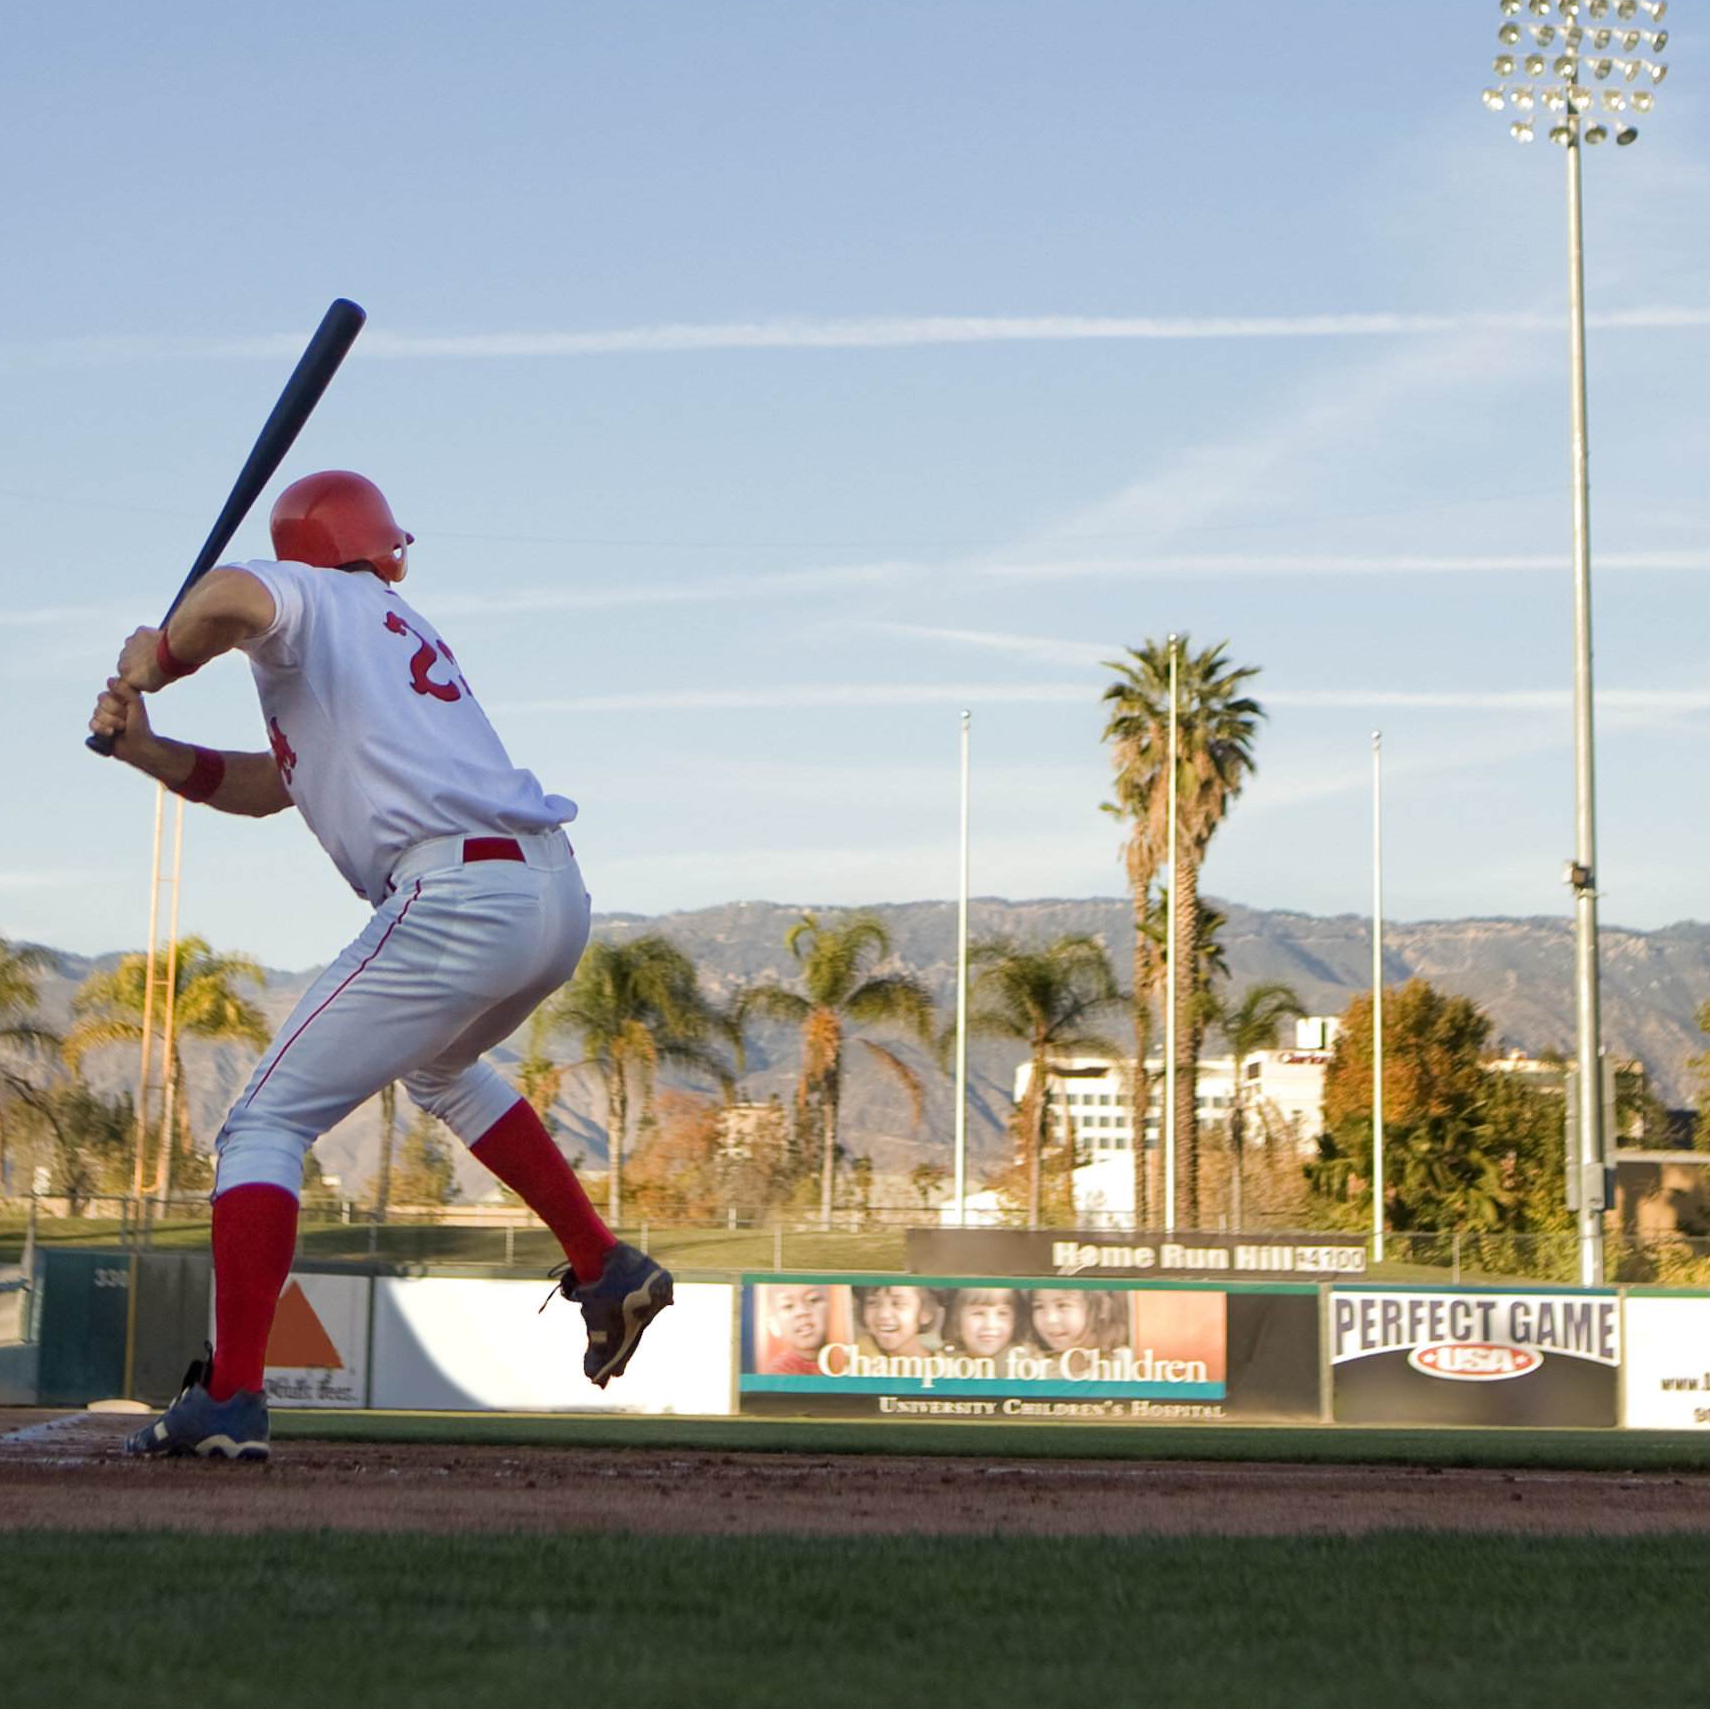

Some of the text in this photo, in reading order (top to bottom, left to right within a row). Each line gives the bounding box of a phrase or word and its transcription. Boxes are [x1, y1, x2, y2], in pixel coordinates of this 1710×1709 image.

[383, 610, 473, 703] 2
[1052, 1241, 1157, 1270] Home
[1160, 1243, 1229, 1270] Run
[1234, 1244, 1294, 1272] Hill
[1335, 1298, 1615, 1358] PERFECT GAME
[816, 1342, 1208, 1389] Champion for Children
[1435, 1346, 1518, 1373] USA
